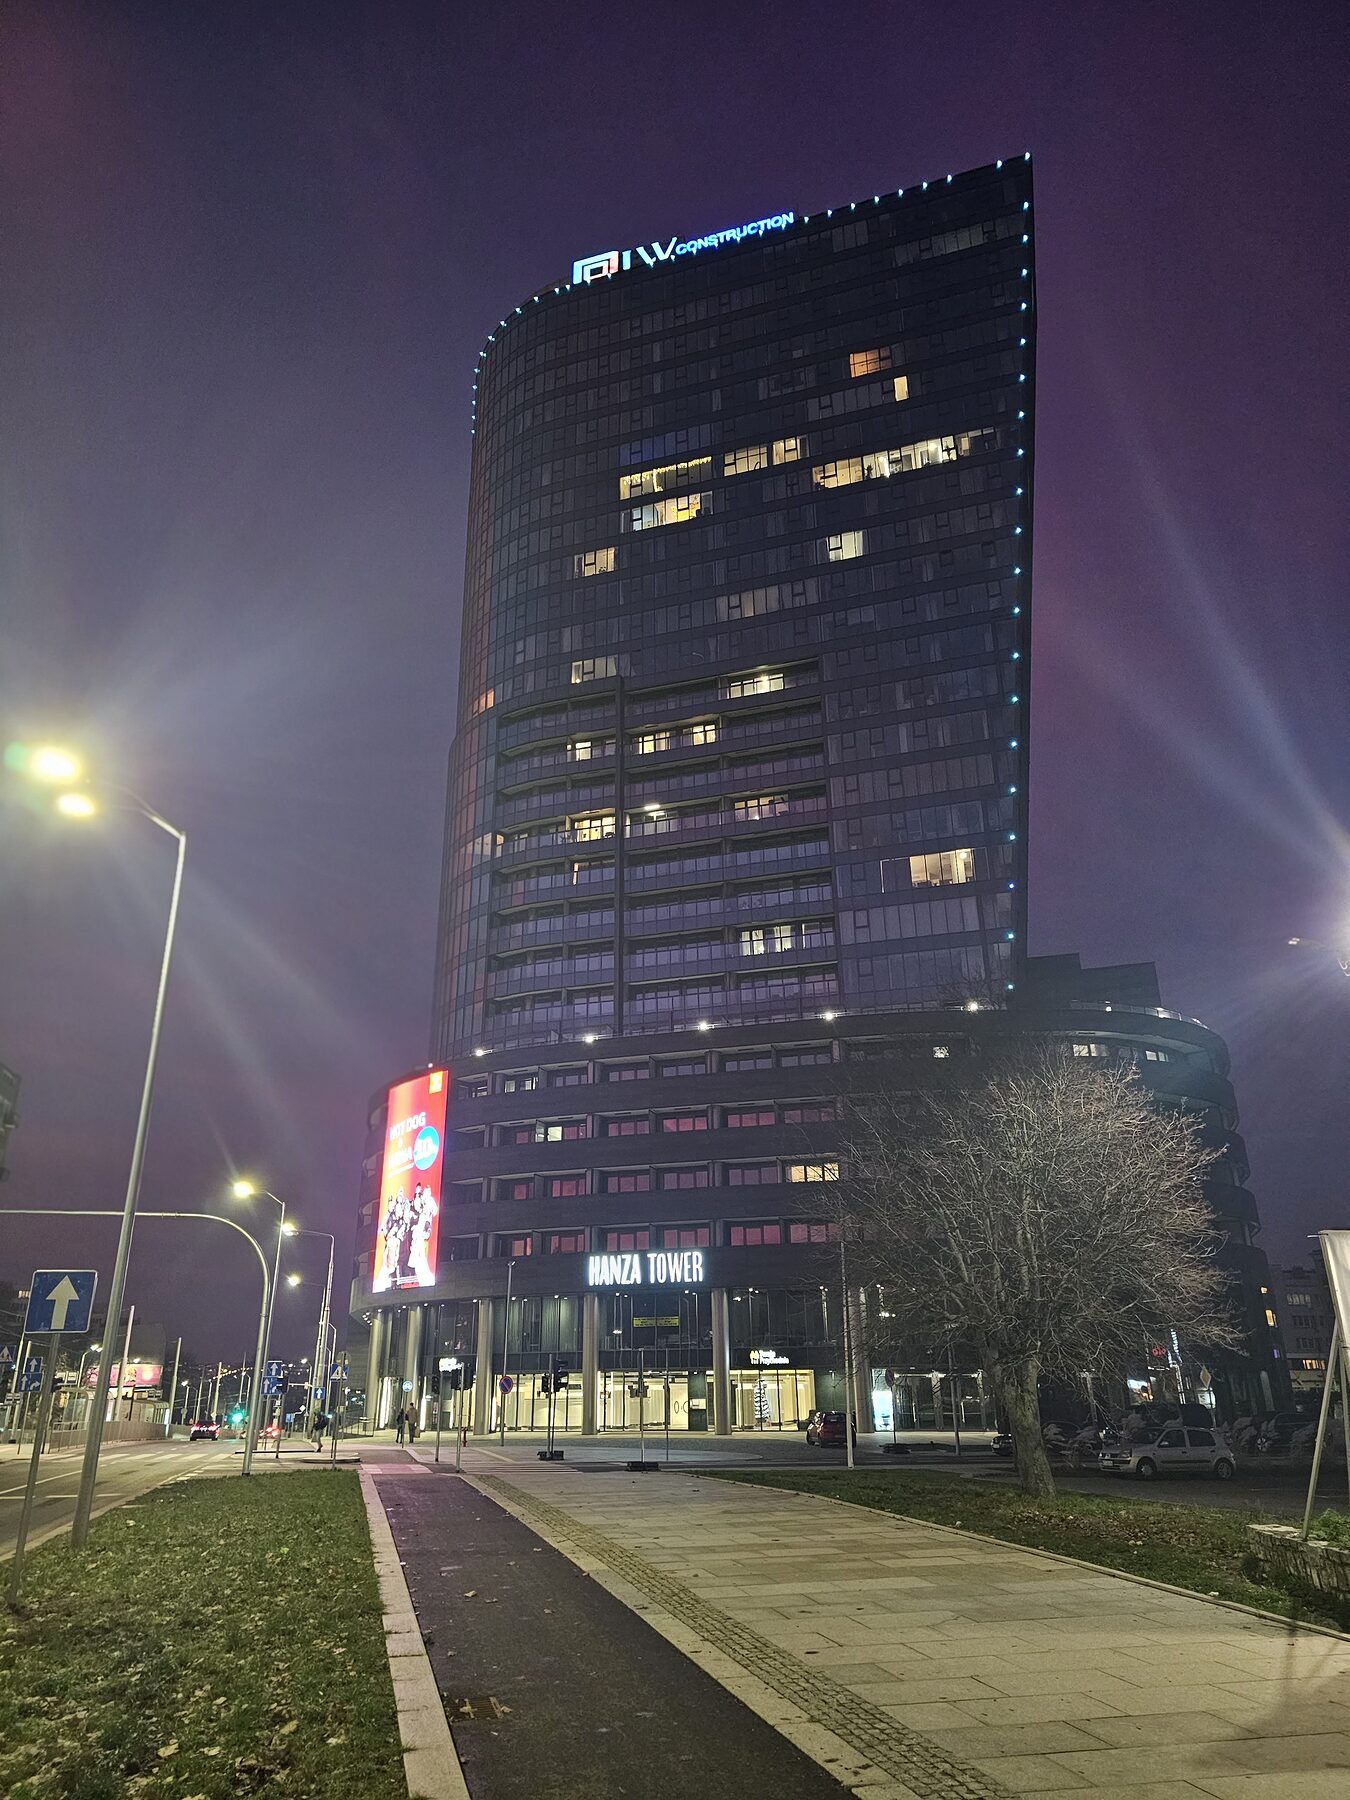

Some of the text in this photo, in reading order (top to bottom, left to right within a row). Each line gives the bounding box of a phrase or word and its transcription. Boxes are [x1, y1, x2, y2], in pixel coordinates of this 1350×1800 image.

[675, 211, 795, 255] CONSTRUCTION
[406, 1111, 427, 1133] DOG
[588, 1251, 704, 1286] HANZA TOWER
